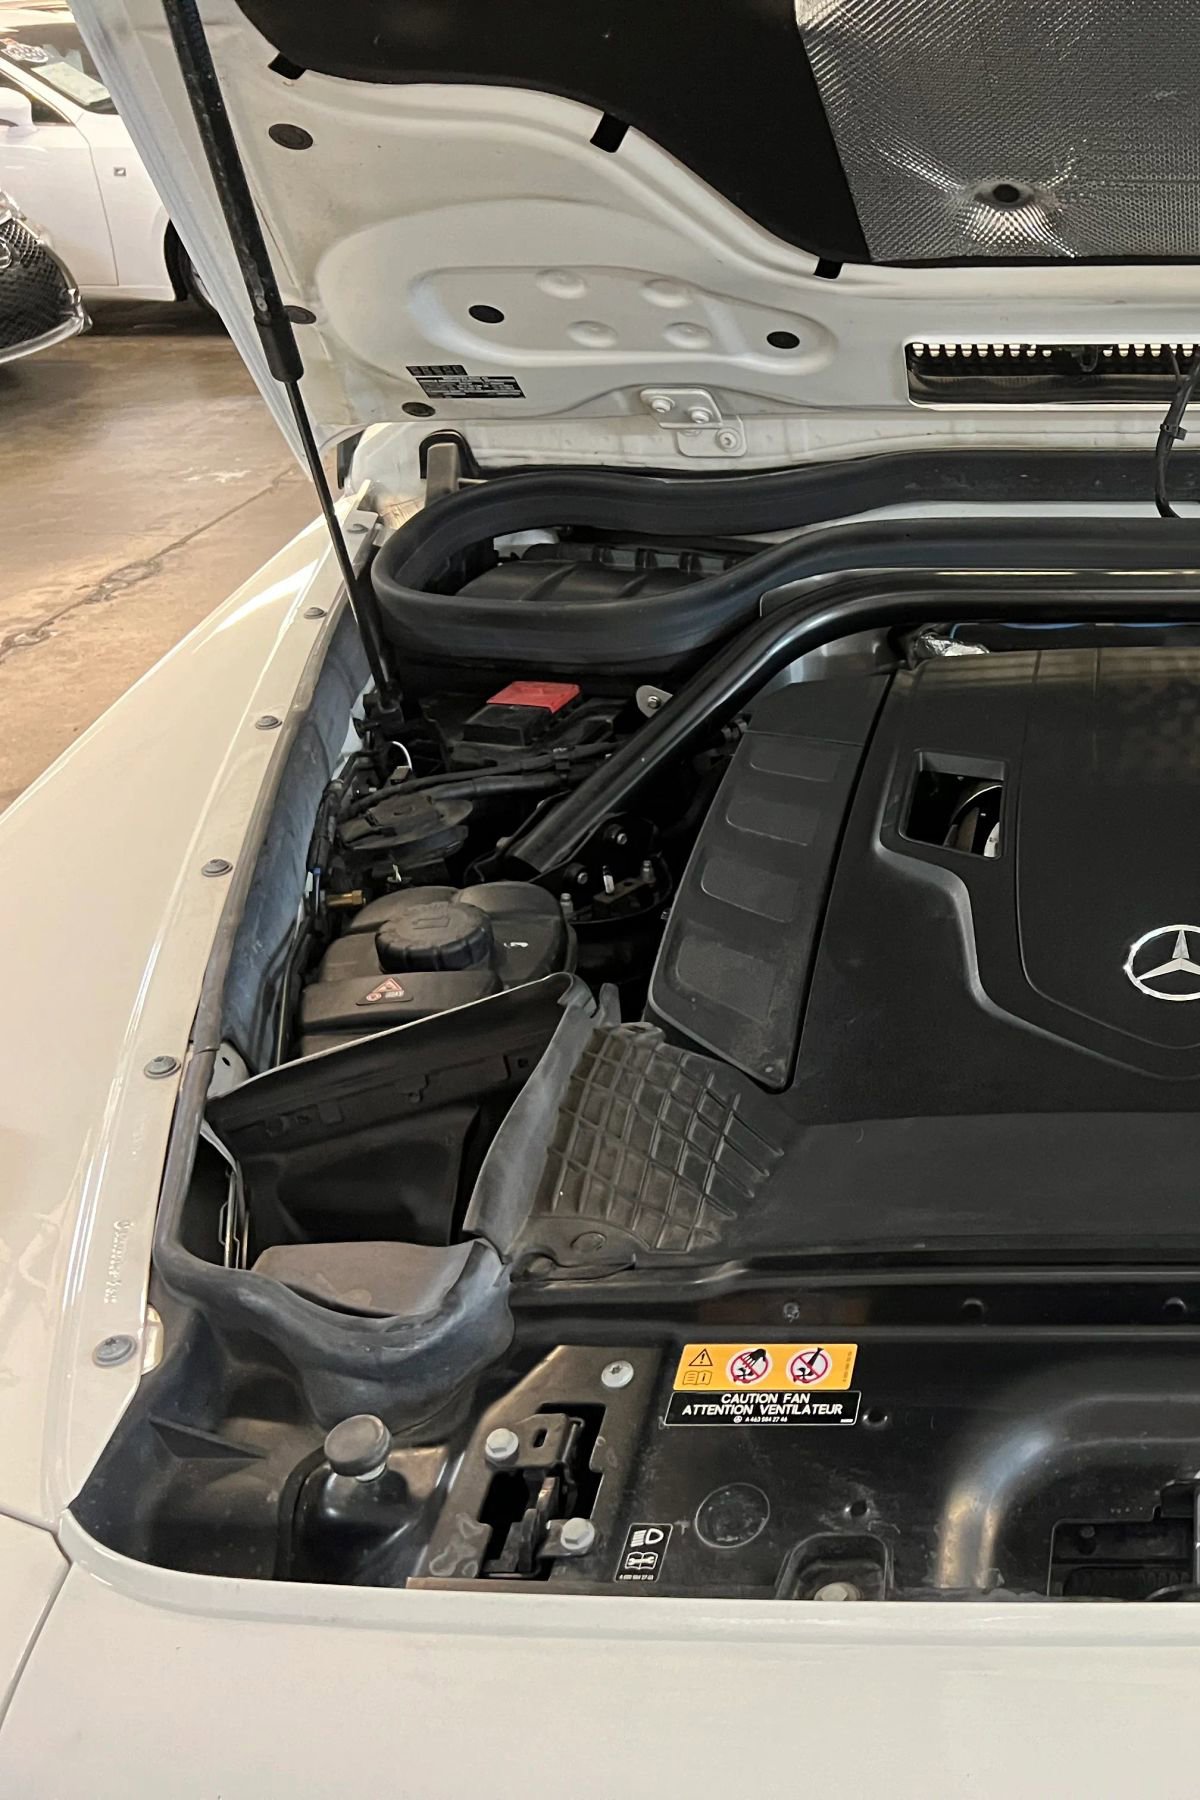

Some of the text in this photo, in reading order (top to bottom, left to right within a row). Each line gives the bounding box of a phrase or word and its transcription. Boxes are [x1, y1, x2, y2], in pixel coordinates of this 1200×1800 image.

[721, 1393, 810, 1404] CAUTION FAN
[682, 1404, 843, 1415] ATTENTION VENTILATEUR
